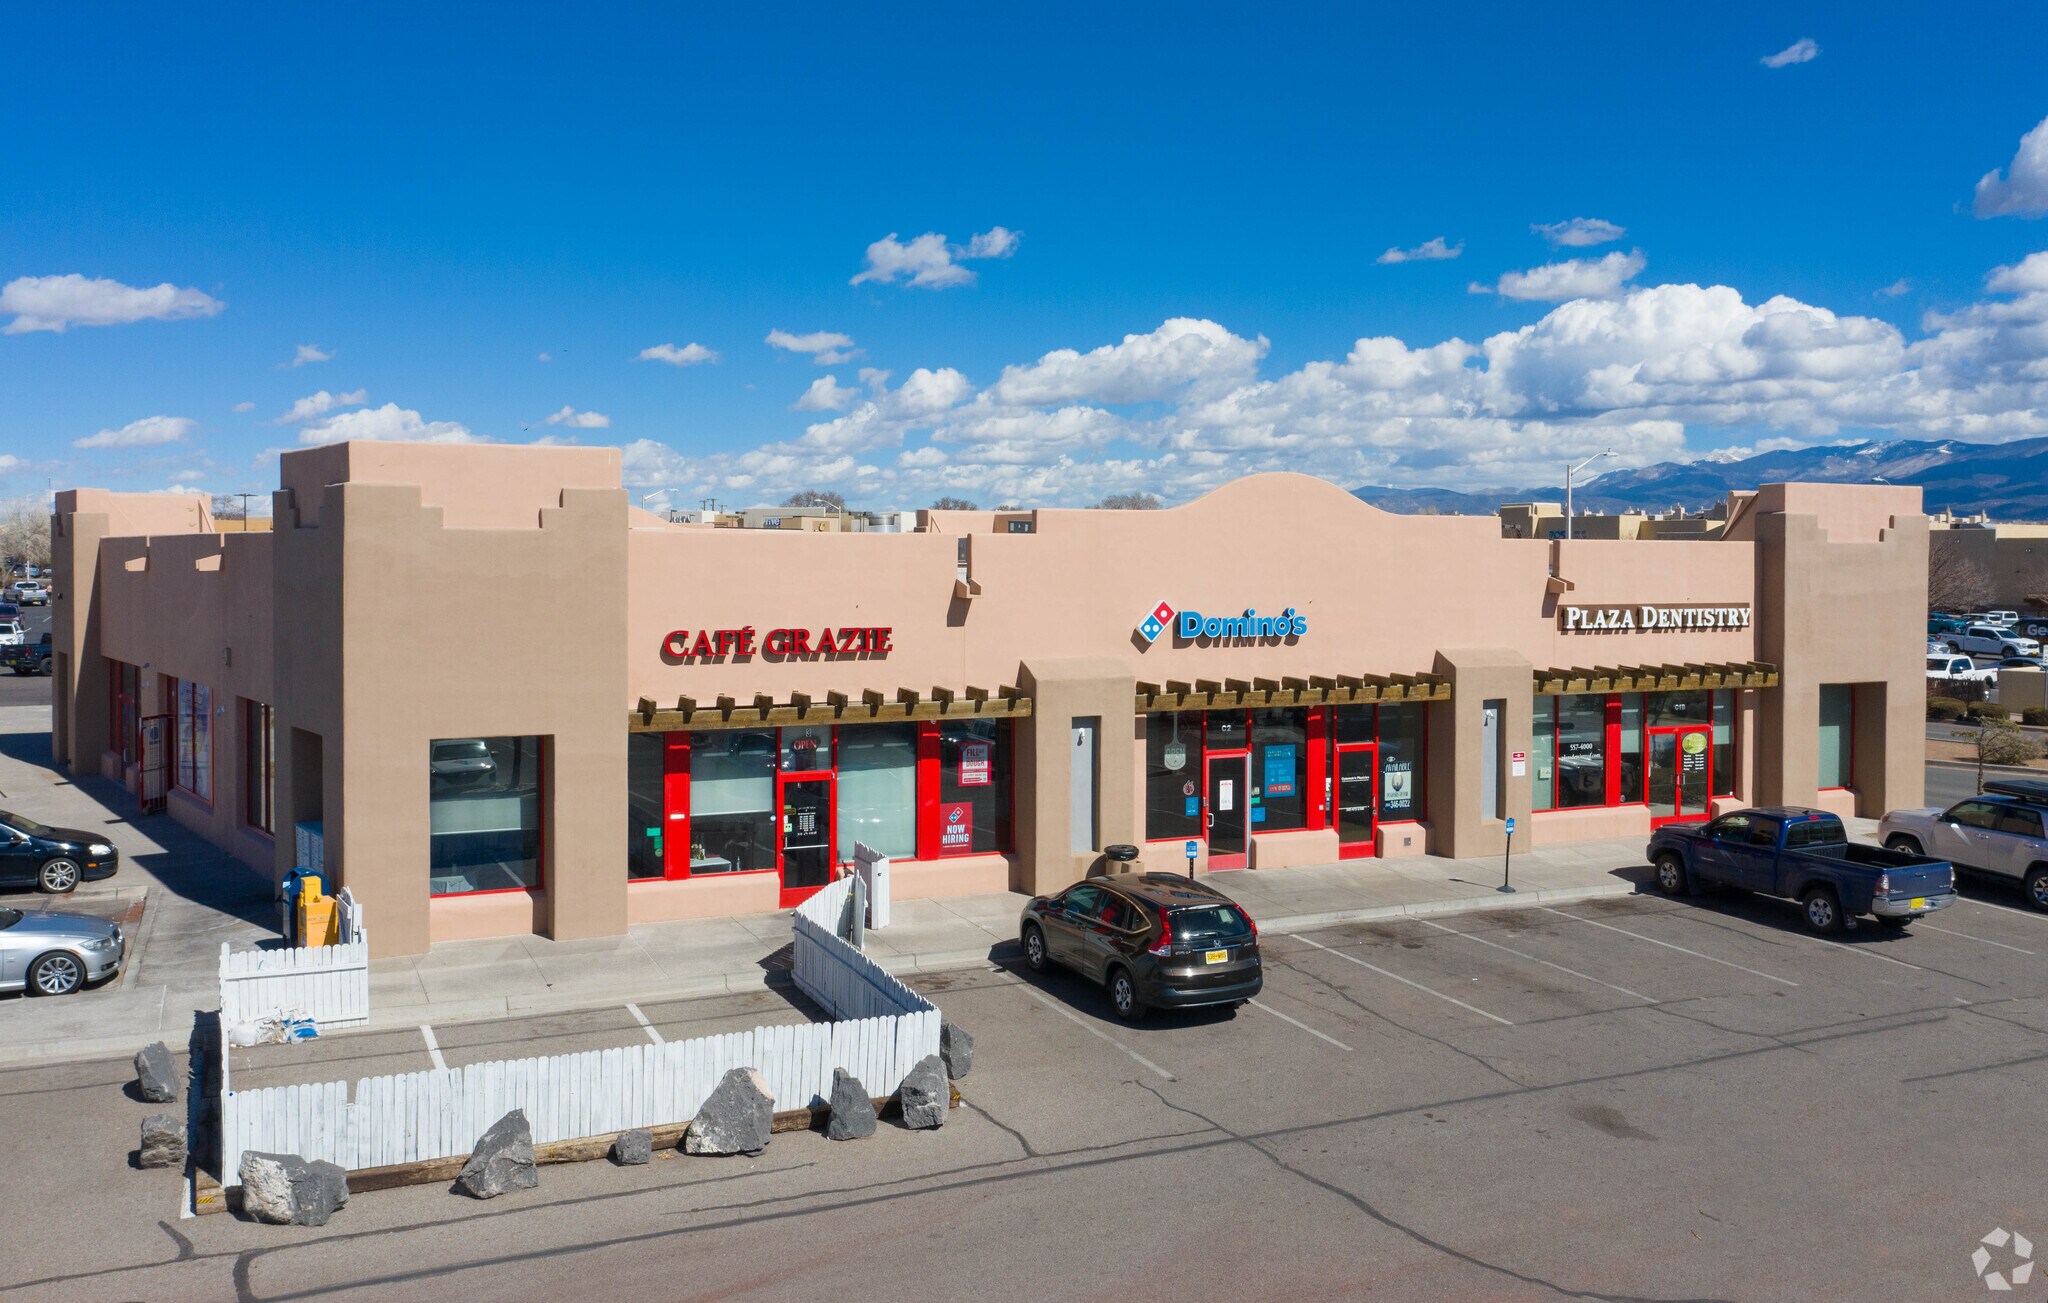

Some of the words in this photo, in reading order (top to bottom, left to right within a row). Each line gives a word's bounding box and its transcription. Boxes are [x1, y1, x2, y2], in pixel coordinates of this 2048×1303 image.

[1180, 607, 1308, 638] Domino's
[1566, 606, 1635, 629] PLAZA
[1641, 606, 1752, 628] DENTISTRY
[664, 625, 757, 657] CAFÉ
[765, 627, 893, 655] GRAZIE
[1221, 724, 1232, 732] C2
[793, 738, 817, 750] OPEN
[1166, 748, 1185, 759] OPEN
[947, 824, 965, 835] NOW
[942, 833, 970, 844] HIRING
